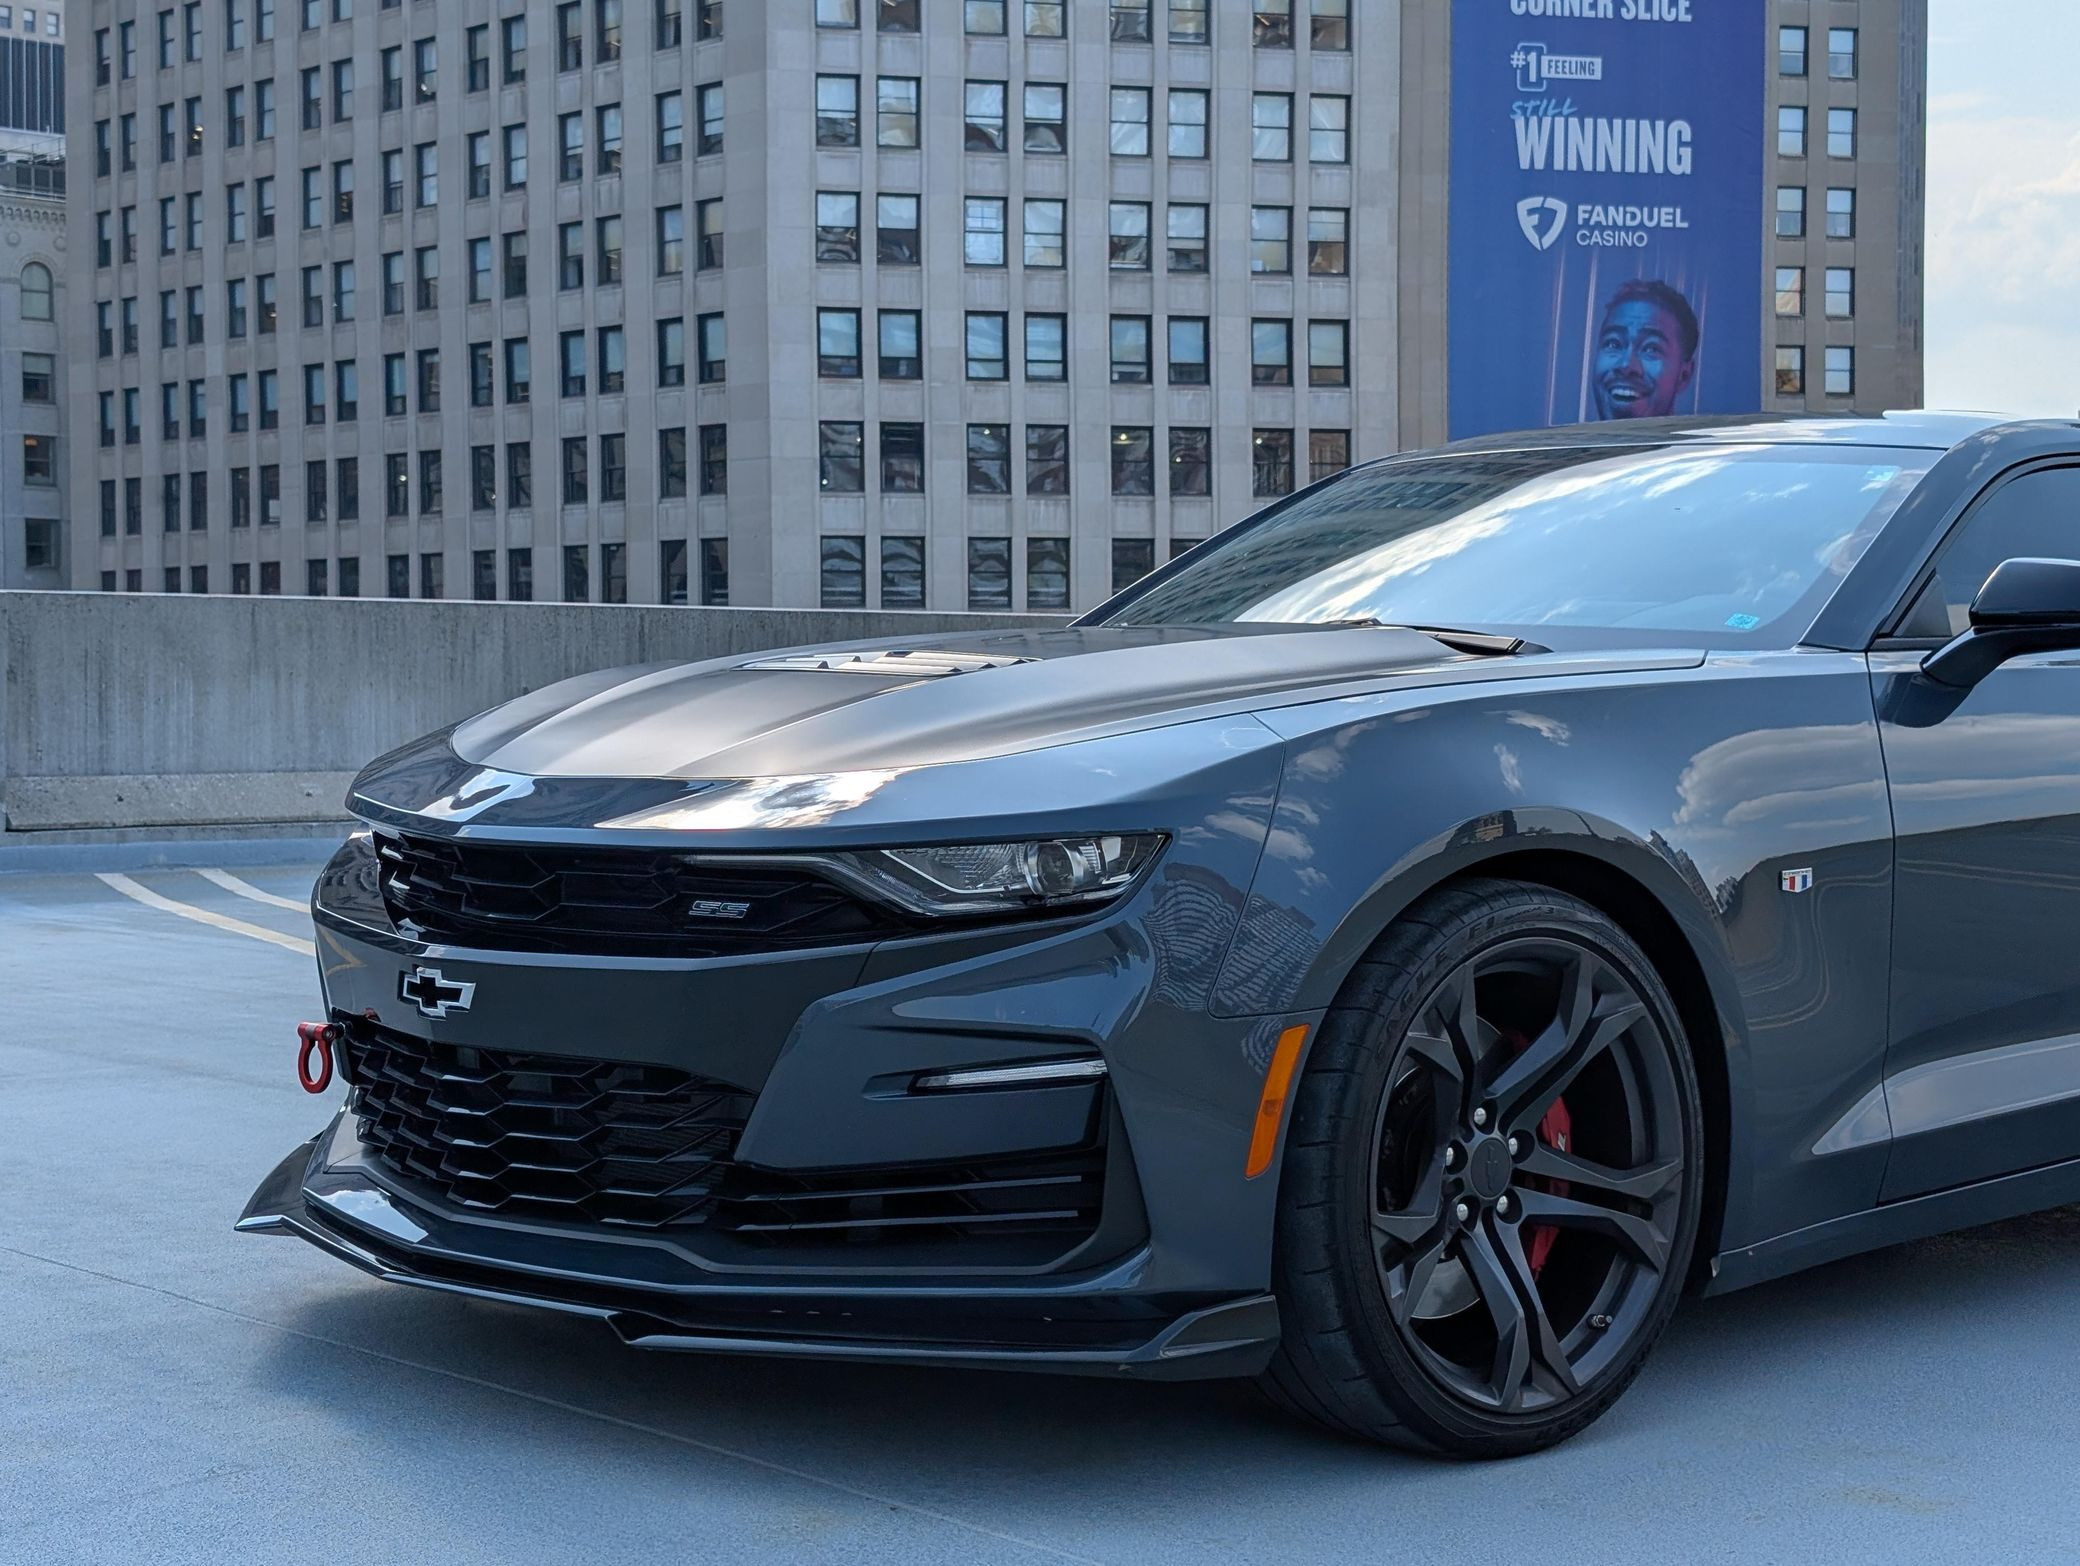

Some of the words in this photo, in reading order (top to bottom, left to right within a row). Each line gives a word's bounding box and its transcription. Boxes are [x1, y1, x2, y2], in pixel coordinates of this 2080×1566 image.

[1510, 50, 1537, 83] #1
[1547, 59, 1595, 76] FEELING
[1509, 97, 1578, 120] STILL
[1514, 115, 1692, 175] WINNING
[1576, 204, 1689, 229] FANDUEL
[1576, 229, 1648, 248] CASINO
